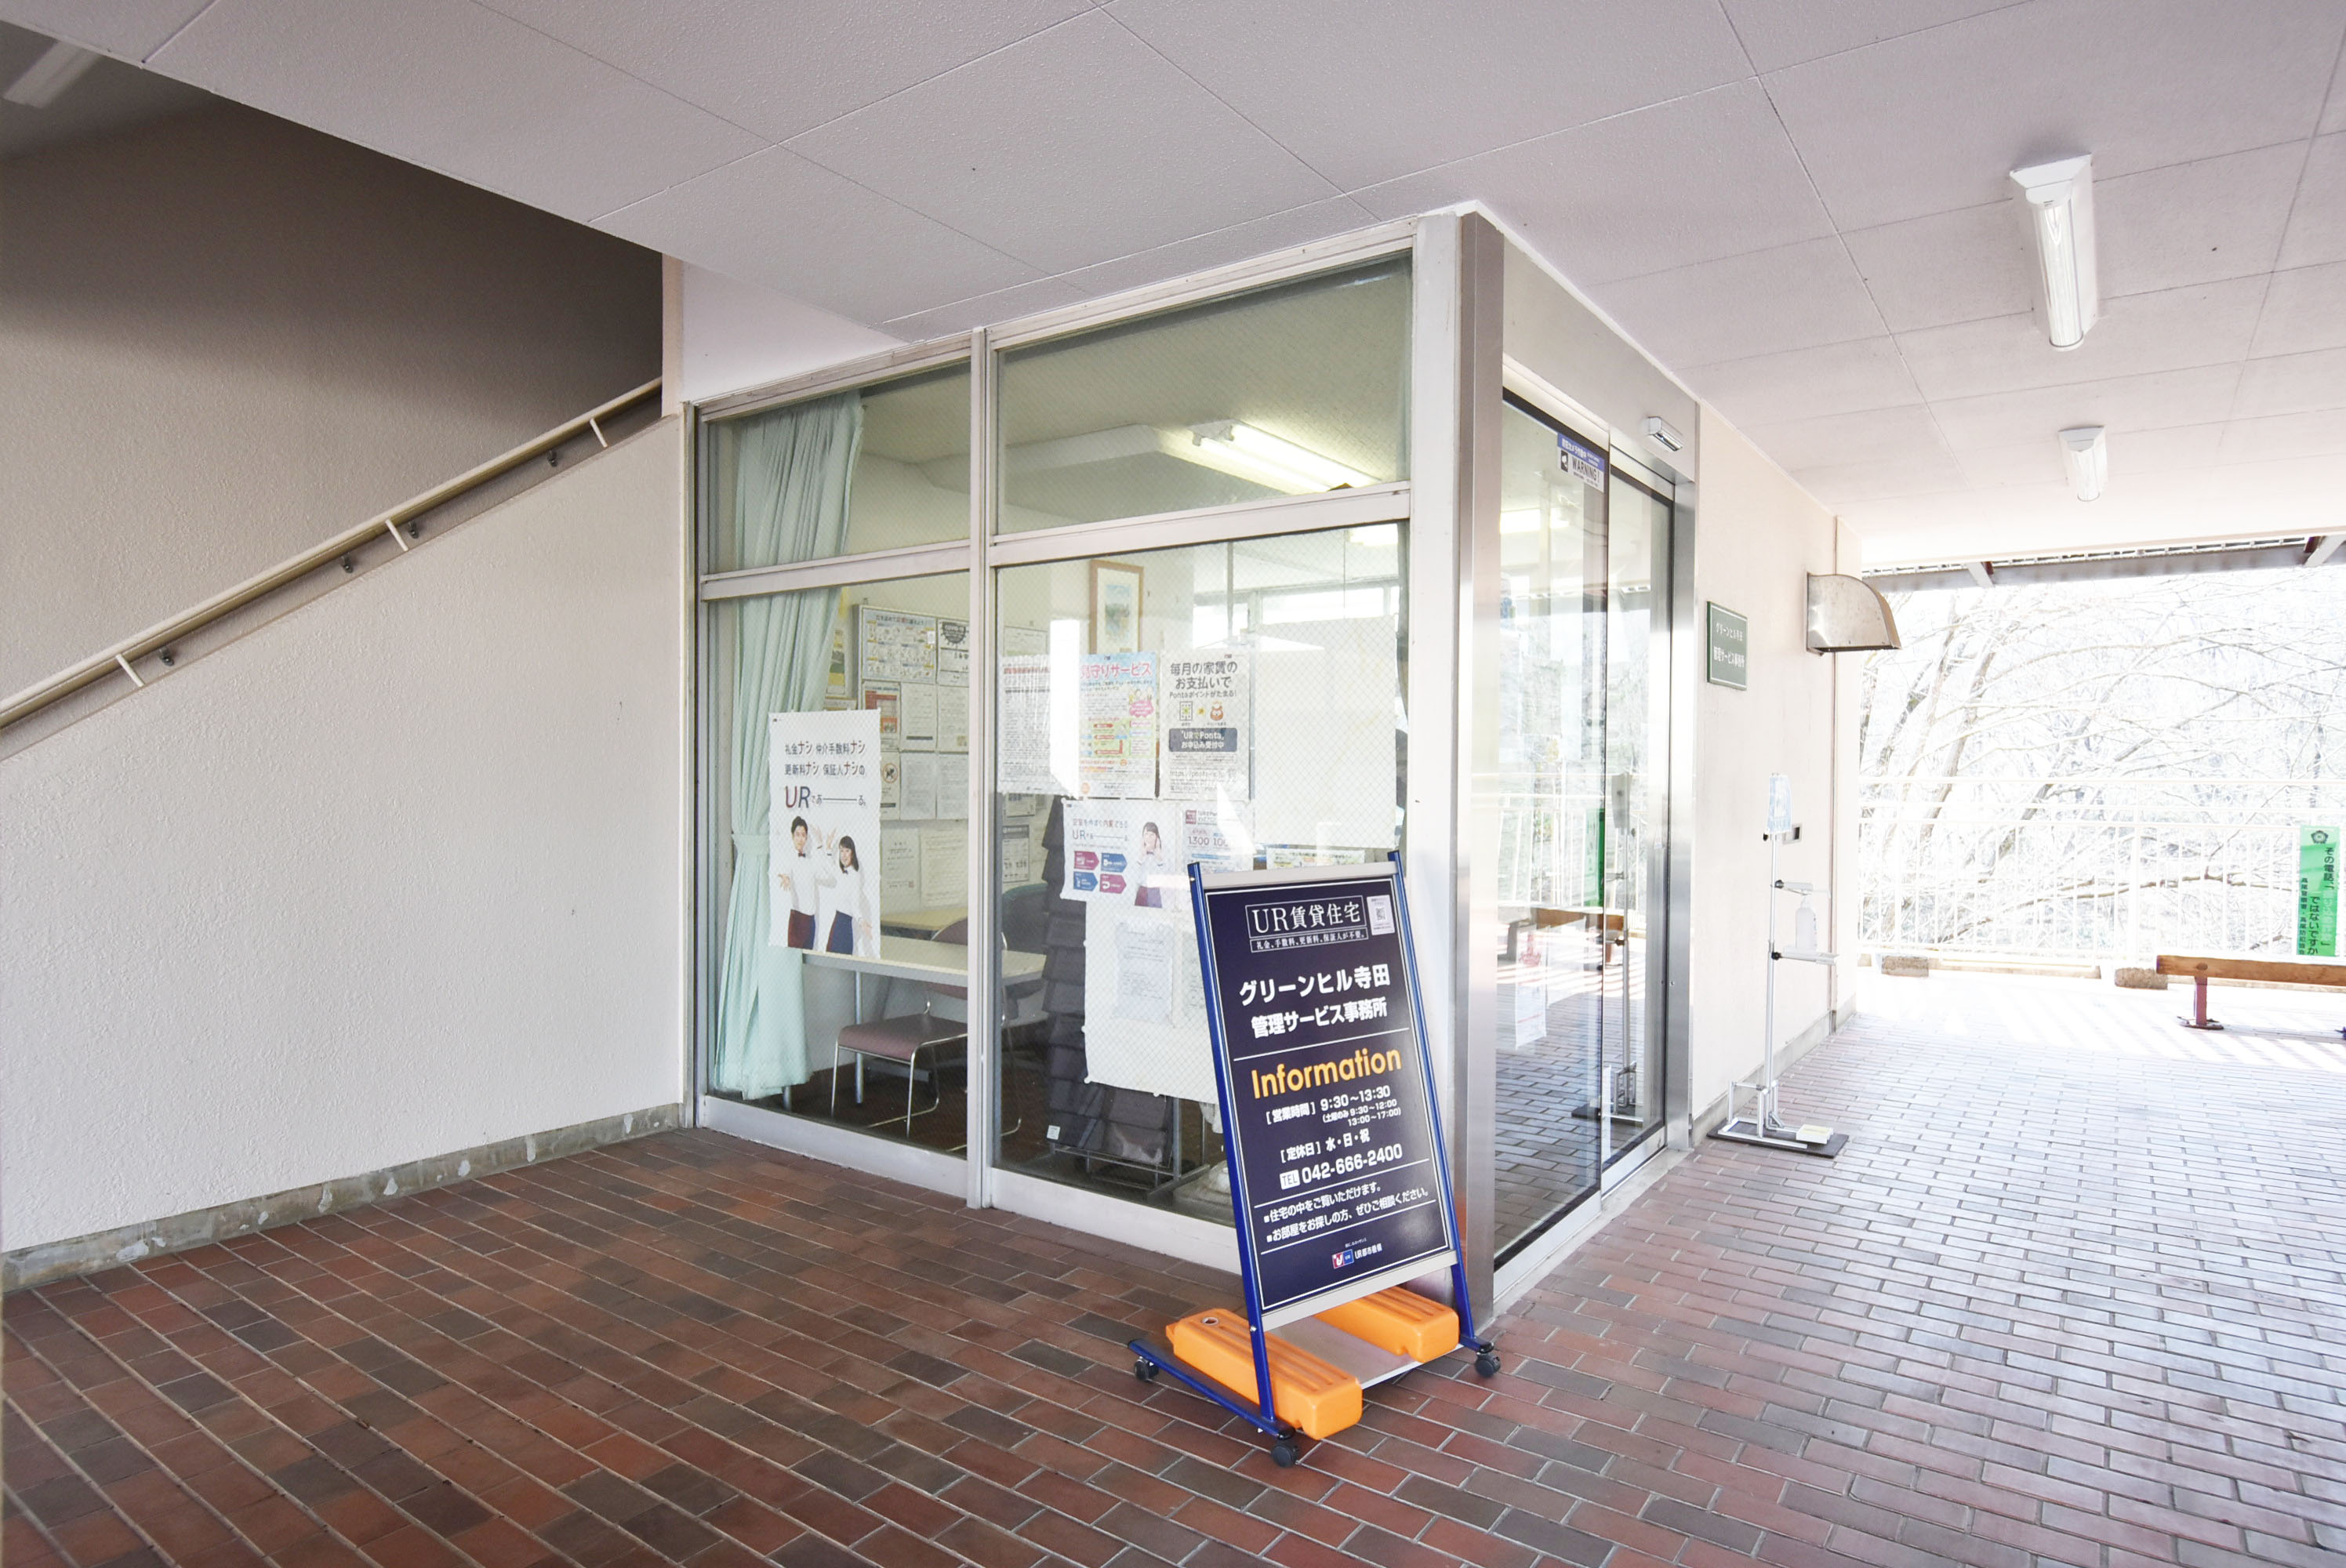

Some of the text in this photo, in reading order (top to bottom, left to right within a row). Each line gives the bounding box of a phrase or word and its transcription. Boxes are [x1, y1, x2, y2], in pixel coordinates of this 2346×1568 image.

[1170, 660, 1238, 676] 毎月の家賃の
[1175, 676, 1232, 690] お支払いで
[784, 739, 866, 755] 礼金ナシ 仲介手数料ナシ
[784, 761, 866, 776] 更新料ナシ 保証人ナシの
[1251, 901, 1361, 934] UR賃貸住宅
[2308, 896, 2320, 955] ではないですか
[1239, 964, 1391, 1007] グリーンヒル寺田
[1251, 996, 1388, 1039] 管理サービス事務所
[1251, 1047, 1402, 1099] Information
[1282, 1143, 1403, 1187] TEL 042-666-2400
